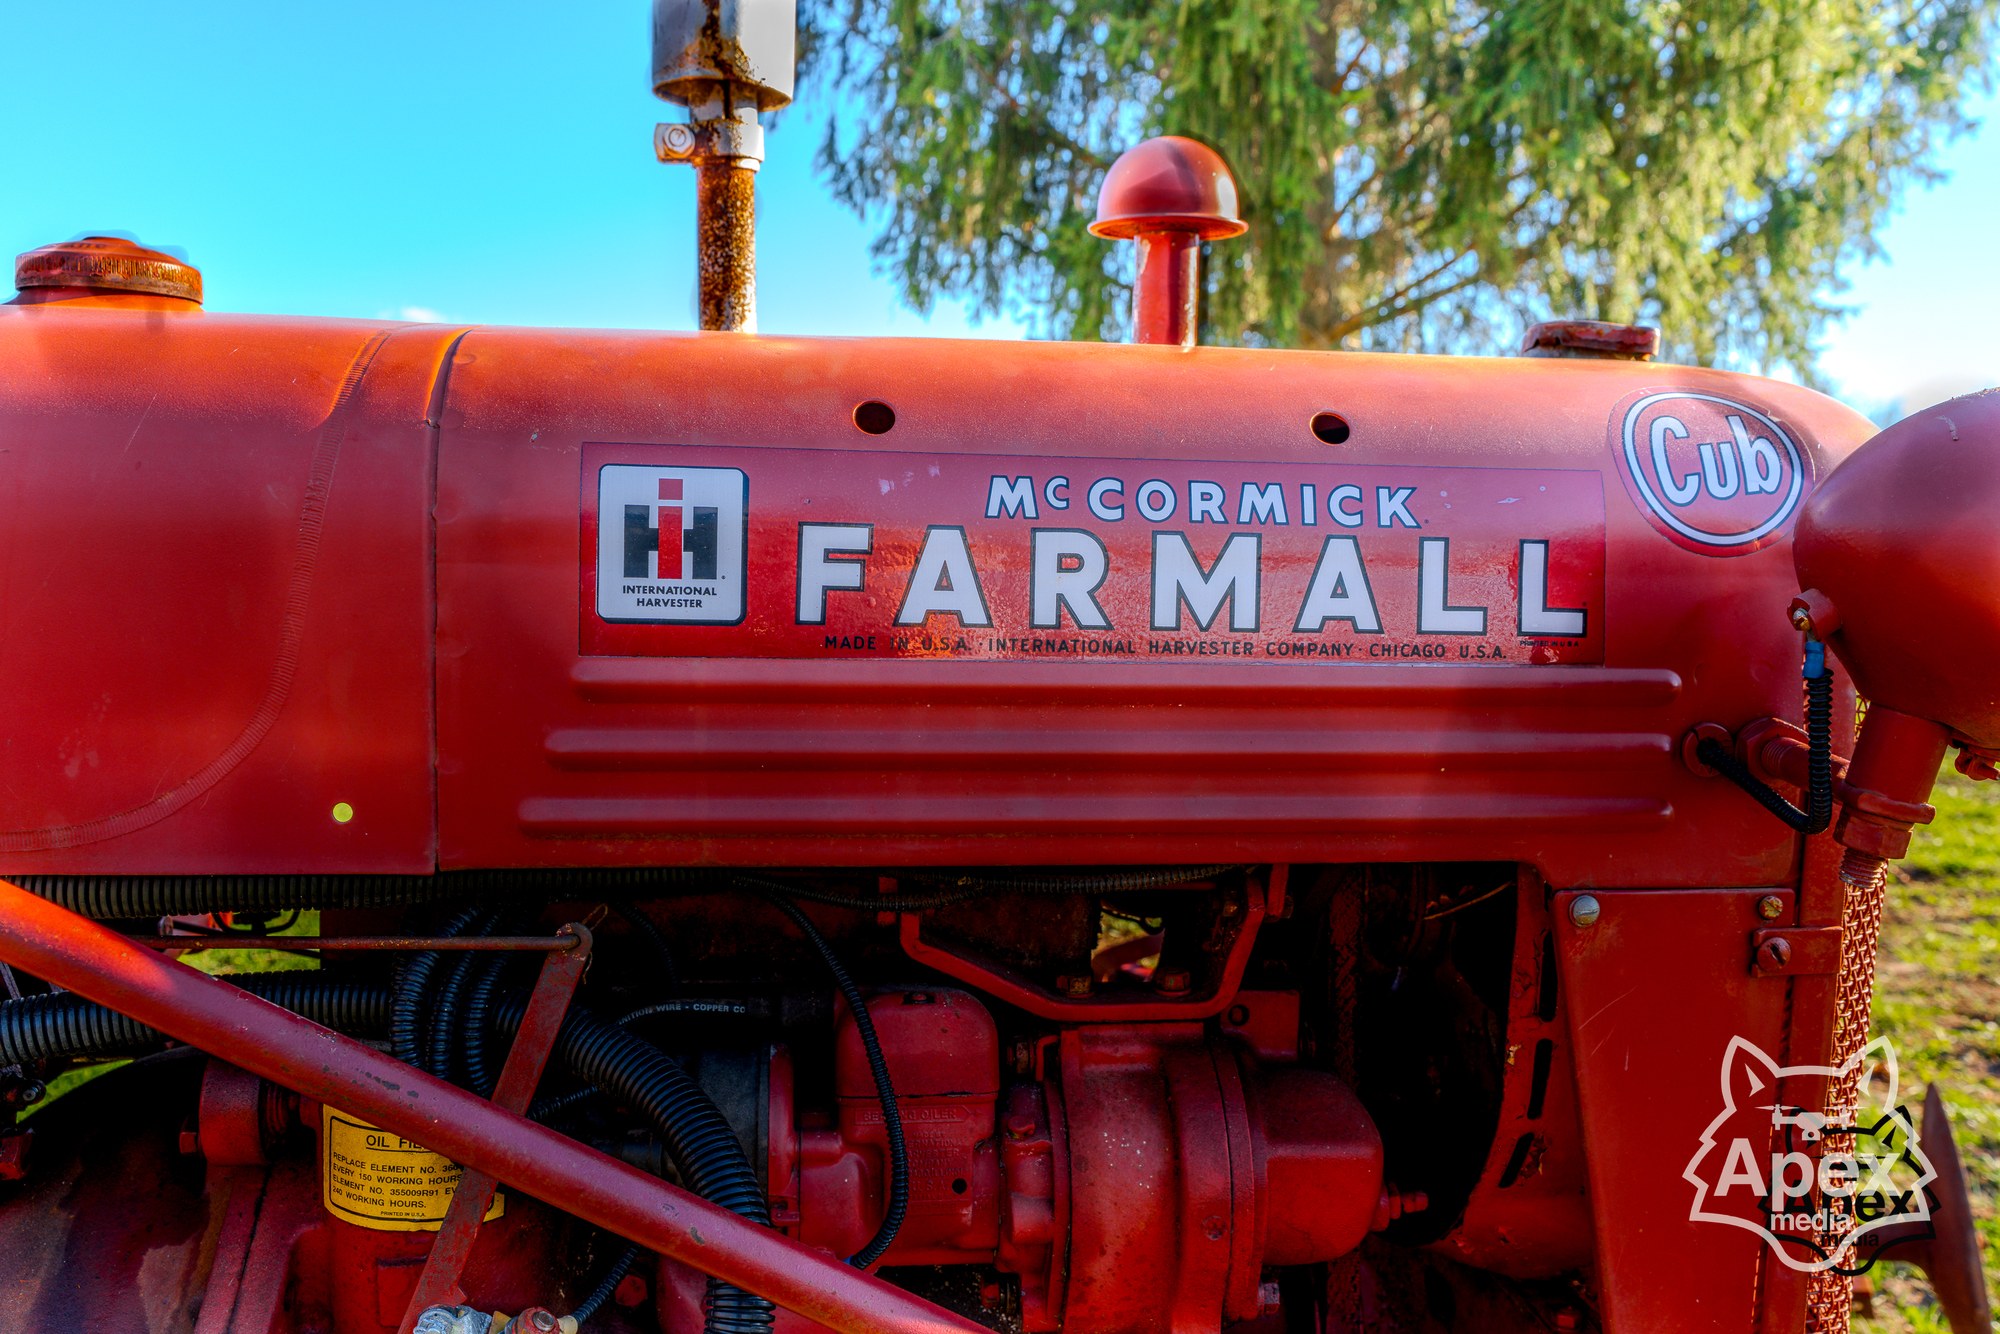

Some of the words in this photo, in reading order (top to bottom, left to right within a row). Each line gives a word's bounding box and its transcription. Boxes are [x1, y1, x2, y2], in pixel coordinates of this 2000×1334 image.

[1649, 414, 1783, 507] Cub
[622, 585, 718, 596] INTERNATIONAL
[794, 521, 1588, 638] FARMALL
[636, 598, 703, 608] HARVESTER
[824, 635, 877, 650] MADE
[890, 636, 909, 650] IN
[921, 637, 972, 651] U.S.A.
[988, 637, 1136, 655] INTERNATIONAL
[1149, 640, 1254, 656] HARVESTER
[1369, 642, 1446, 659] CHICAGO
[1459, 644, 1507, 660] U.S.A.
[655, 1003, 682, 1012] WIRE
[693, 1003, 729, 1013] COPPER
[366, 1135, 390, 1148] OIL
[333, 1151, 366, 1170] REPLACE
[370, 1163, 415, 1173] ELEMENT
[420, 1166, 437, 1174] NO.
[333, 1162, 355, 1177] EVERY
[359, 1173, 372, 1182] 150
[377, 1175, 423, 1185] WORKING
[332, 1173, 365, 1191] ELEMENT
[369, 1186, 385, 1196] NO.
[389, 1188, 439, 1197] 355009R91
[332, 1185, 343, 1196] 240
[345, 1190, 385, 1207] WORKING
[389, 1199, 427, 1209] HOURS.
